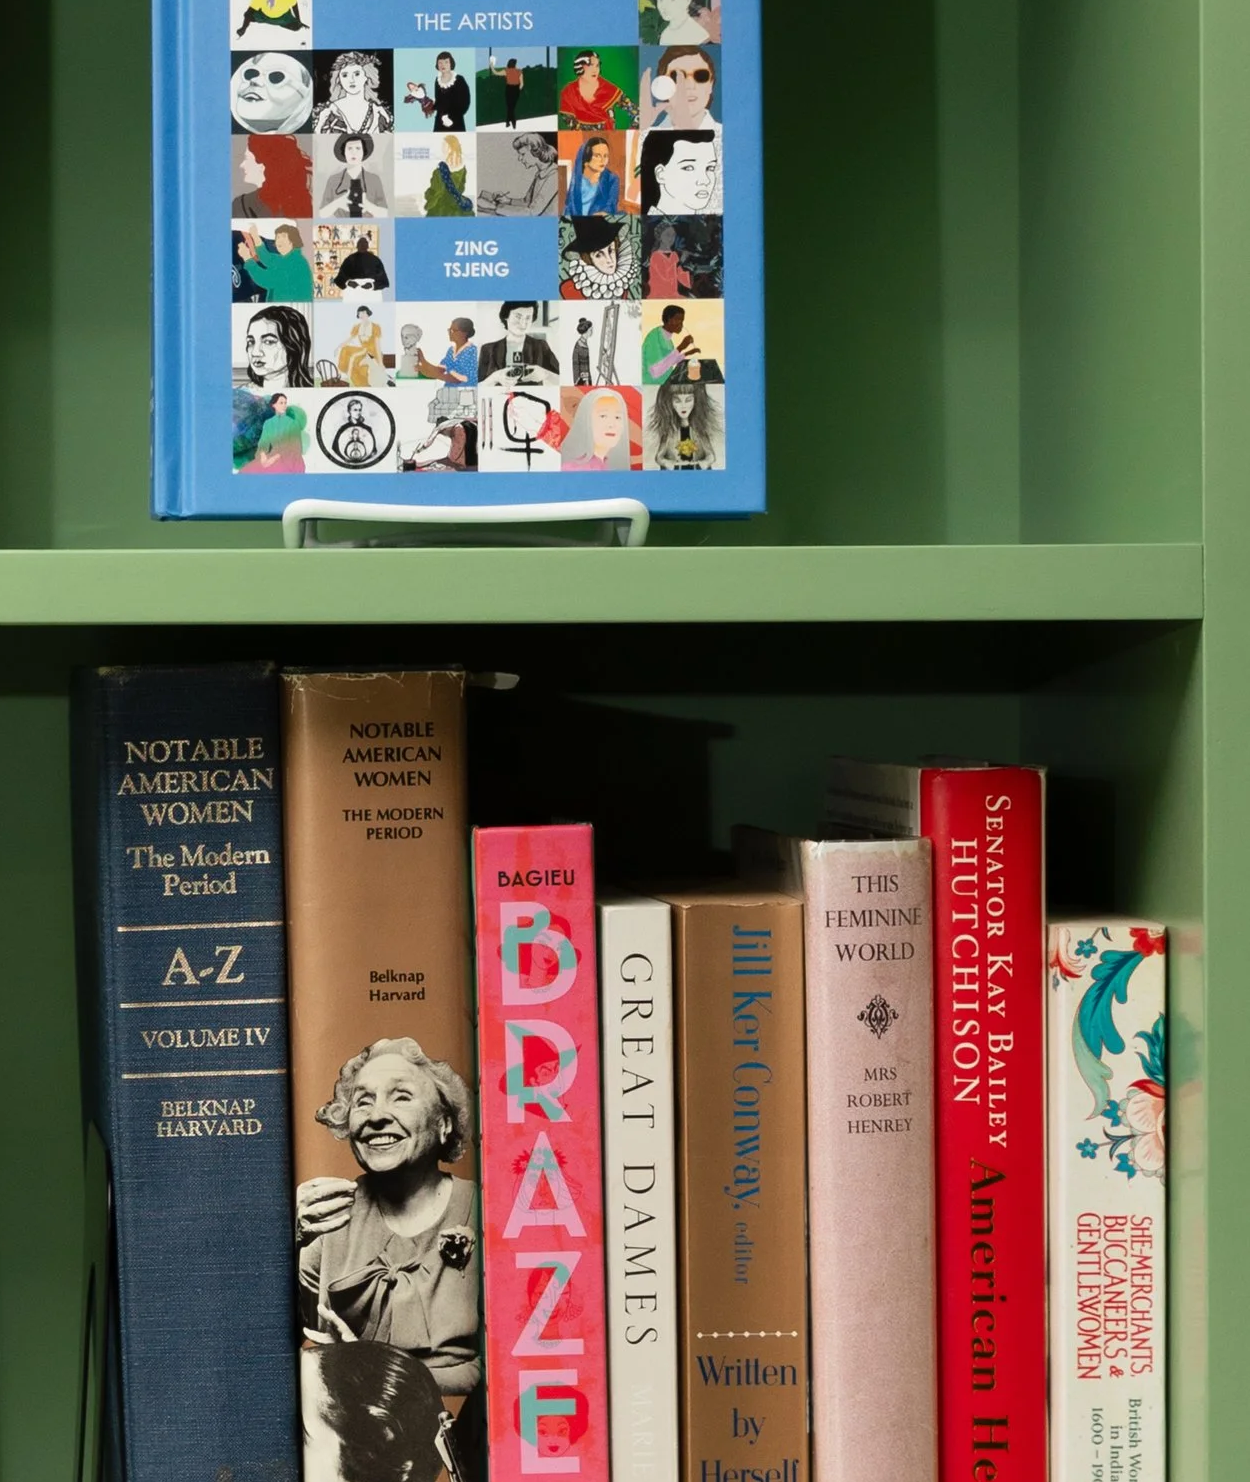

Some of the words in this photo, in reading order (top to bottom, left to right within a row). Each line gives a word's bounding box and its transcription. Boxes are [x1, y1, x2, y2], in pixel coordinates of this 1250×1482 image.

[414, 12, 451, 31] THE
[456, 12, 534, 30] ARTISTS
[453, 240, 499, 258] ZING
[444, 262, 510, 279] TSJENG
[350, 722, 435, 739] NOTABLE
[123, 738, 264, 764] NOTABLE
[342, 747, 442, 763] AMERICAN
[116, 768, 274, 796] AMERICAN
[354, 771, 431, 787] WOMEN
[140, 801, 254, 827] WOMEN
[126, 846, 175, 869] The
[180, 845, 271, 866] Modern
[161, 873, 238, 899] Period
[497, 870, 575, 888] BAGIEU
[852, 875, 899, 894] THIS
[824, 908, 922, 929] FEMININE
[731, 924, 773, 977] Jill
[835, 943, 915, 962] WORLD
[369, 970, 425, 985] Belknap
[950, 837, 981, 1105] HUTCHISON
[369, 988, 426, 1002] Harvard
[731, 991, 773, 1051] Ker
[140, 1030, 241, 1050] VOLUME
[244, 1027, 271, 1047] IV
[620, 953, 654, 1129] GREAT
[863, 1067, 897, 1082] MRS
[846, 1092, 912, 1108] ROBERT
[724, 1060, 773, 1211] Conway,
[847, 1119, 913, 1134] HENREY
[623, 1164, 658, 1346] DAMES
[968, 1156, 1009, 1392] American
[1076, 1212, 1102, 1380] GENTLEWOMEN
[1103, 1216, 1128, 1362] BUCCANEERS
[697, 1355, 798, 1386] Written
[1108, 1365, 1121, 1378] &
[732, 1408, 765, 1444] by
[1090, 1406, 1103, 1446] 1600
[1110, 1425, 1122, 1440] in
[1128, 1398, 1143, 1449] British
[1109, 1443, 1121, 1482] India
